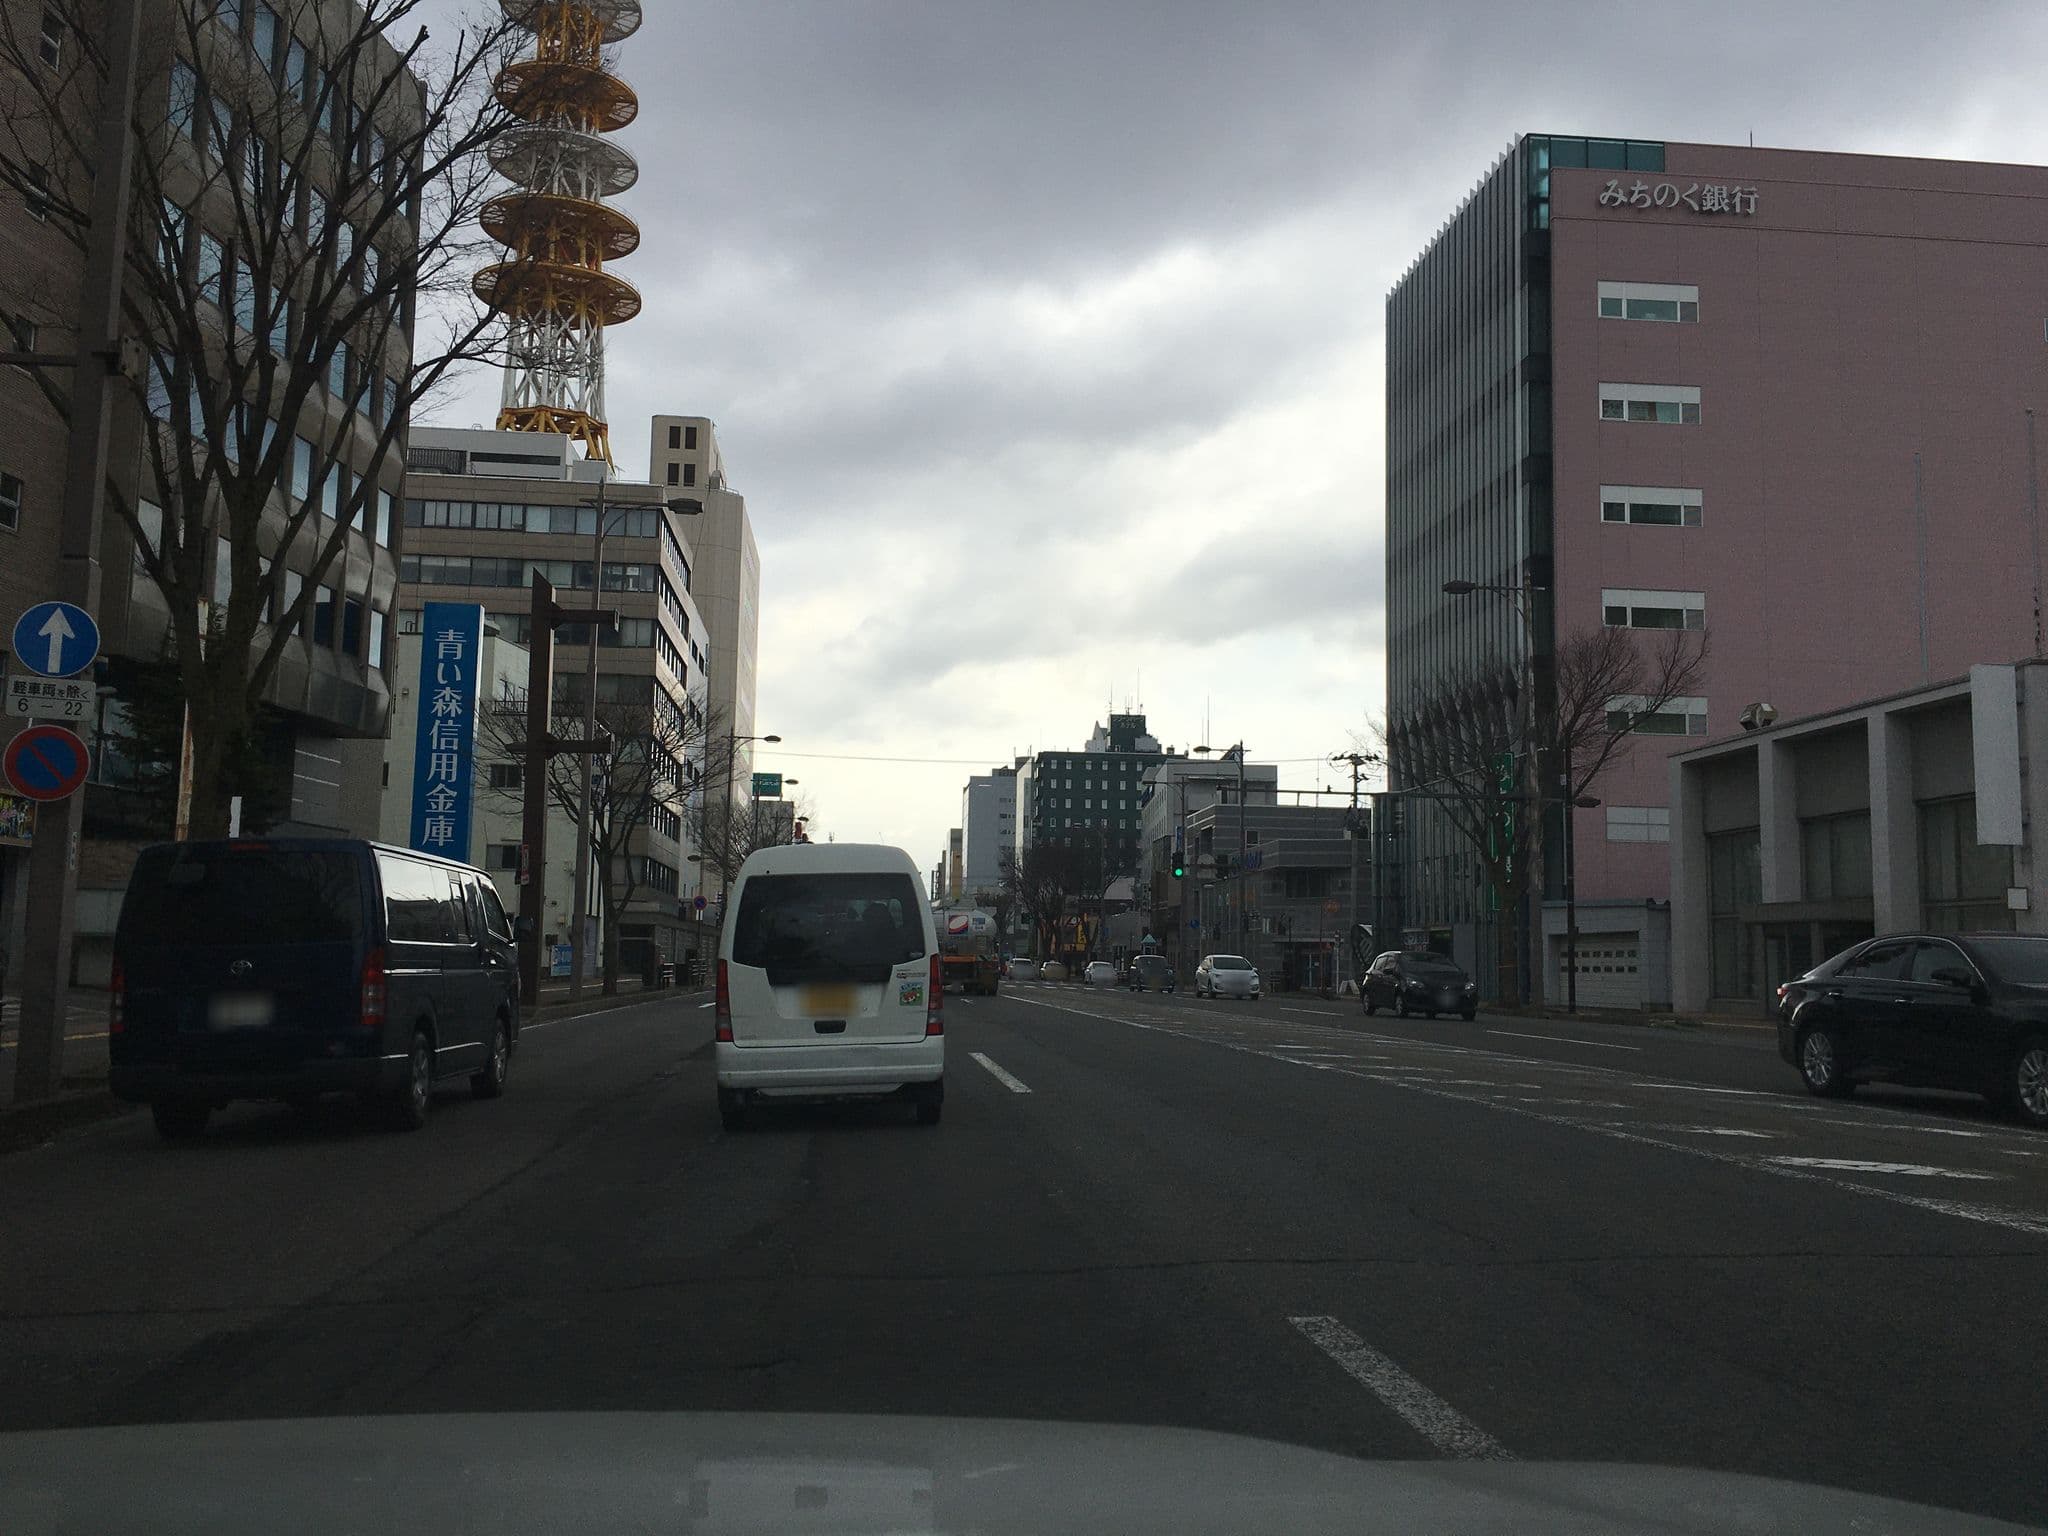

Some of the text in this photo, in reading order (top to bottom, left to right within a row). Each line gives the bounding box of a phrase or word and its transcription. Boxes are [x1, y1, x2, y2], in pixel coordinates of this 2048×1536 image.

[1599, 178, 1760, 214] みちのく銀行
[13, 681, 89, 699] 軽車両を除く
[18, 698, 29, 712] 6
[65, 701, 83, 716] 22
[422, 629, 467, 847] 青い森信用金庫
